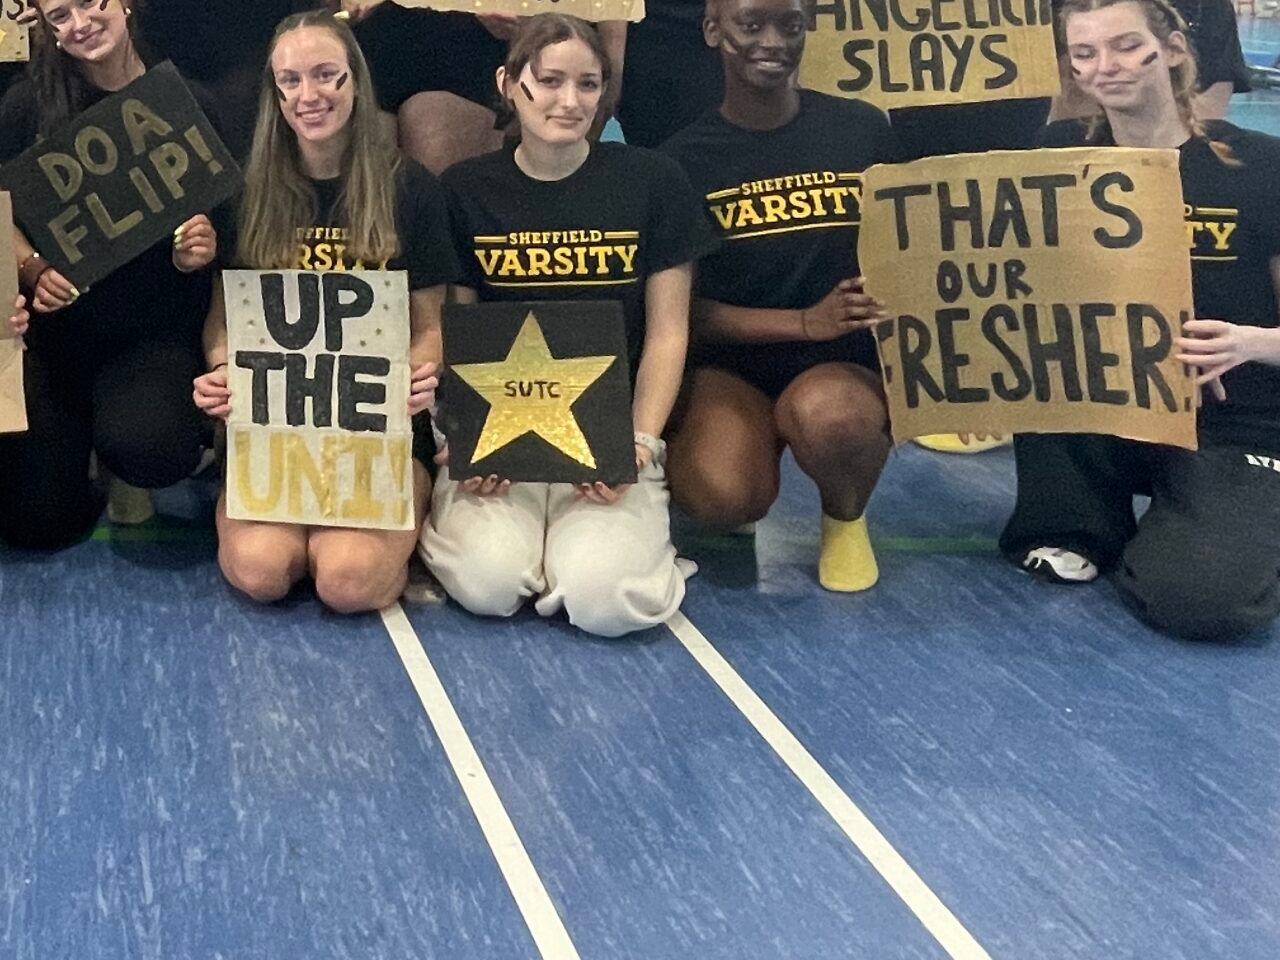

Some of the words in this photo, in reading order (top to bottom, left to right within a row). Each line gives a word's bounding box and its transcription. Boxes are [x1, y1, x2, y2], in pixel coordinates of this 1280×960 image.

[836, 31, 1018, 93] SLAYS
[37, 125, 119, 203] DO
[121, 98, 174, 156] A
[47, 124, 224, 265] FLIP!
[741, 171, 837, 196] SHEFFIELD
[873, 164, 1144, 252] THAT'S
[473, 244, 640, 278] VARSITY
[508, 229, 603, 246] SHEFFIELD
[936, 259, 1033, 303] OUR
[260, 273, 375, 352] UP
[235, 351, 391, 433] THE
[503, 379, 563, 400] SUTC
